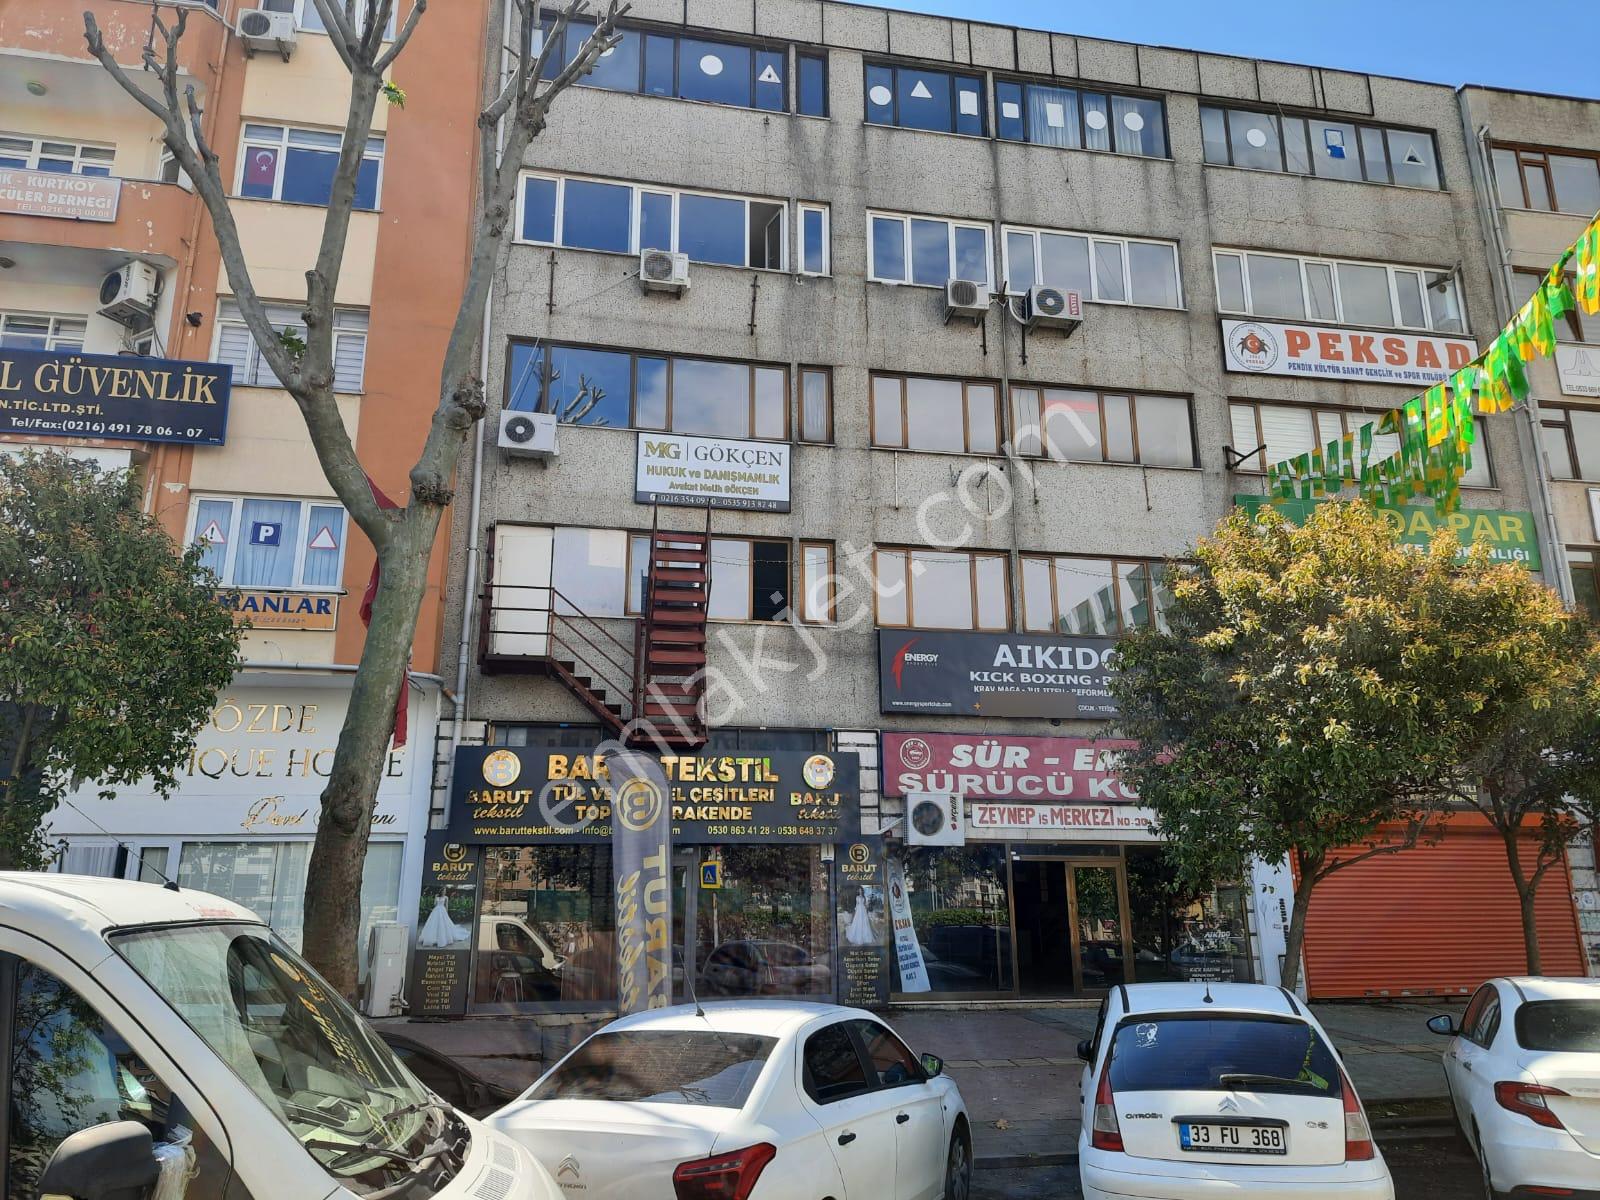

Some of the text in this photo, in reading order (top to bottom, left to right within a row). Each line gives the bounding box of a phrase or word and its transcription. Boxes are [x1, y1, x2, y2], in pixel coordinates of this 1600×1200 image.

[1285, 329, 1471, 370] PEKSAD
[1314, 362, 1341, 375] KÜLTÜR
[1342, 366, 1363, 377] SANAT
[1403, 370, 1421, 380] SPOR
[34, 357, 218, 405] GÜVENLİK
[108, 423, 131, 434] 491
[136, 425, 152, 435] 78
[156, 426, 173, 437] 06
[186, 428, 204, 438] 07
[694, 443, 783, 469] GÖKÇEN
[646, 464, 781, 485] HUKUK ve DANIŞMANLIK
[660, 494, 680, 503] 0216
[723, 498, 741, 507] 0535
[1448, 513, 1527, 543] PAR
[904, 652, 939, 662] ENERGY
[969, 671, 1015, 683] KICK
[1020, 672, 1092, 686] BOXING
[950, 740, 1030, 769] SÜR
[286, 749, 404, 778] HOE
[899, 769, 1074, 797] SÜRÜCÜ
[465, 789, 534, 805] BARUT
[690, 785, 775, 804] ÇEŞİTLERİ
[472, 803, 525, 820] tekstil
[978, 806, 1036, 825] ZEYNEP
[1050, 806, 1115, 827] MERKEZİ
[474, 825, 574, 836] www.baruttekstil.com
[708, 826, 838, 836] 0530 863 41 28 0538 648 37 37
[432, 862, 474, 872] BARUT
[842, 864, 877, 873] BARUT
[436, 871, 469, 881] tekstil
[846, 872, 873, 881] tekstil
[1191, 1125, 1210, 1143] 33
[1221, 1127, 1239, 1145] FU
[1251, 1129, 1280, 1147] 368
